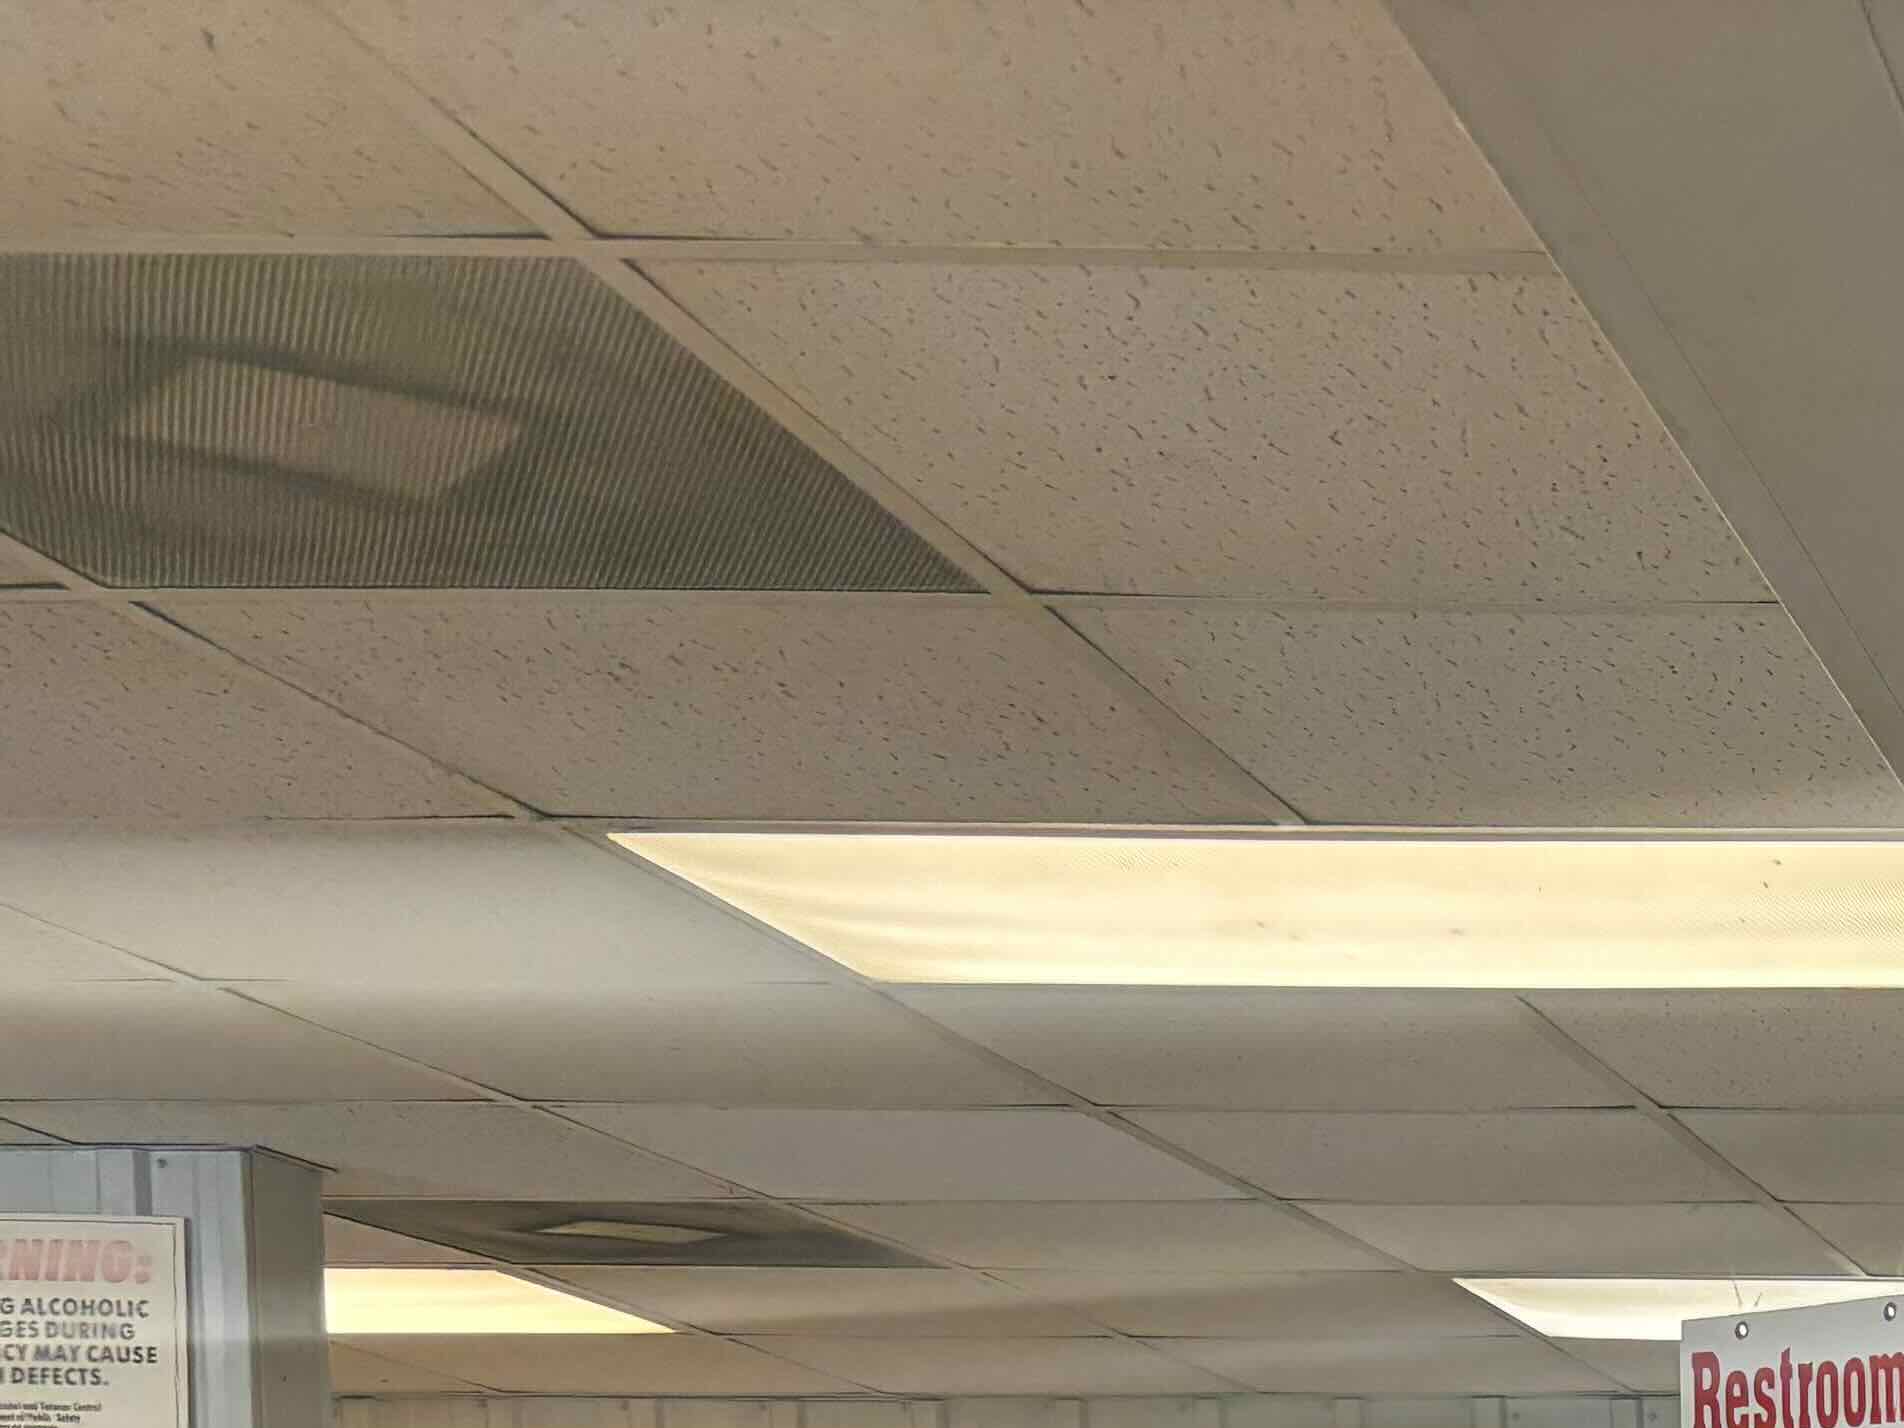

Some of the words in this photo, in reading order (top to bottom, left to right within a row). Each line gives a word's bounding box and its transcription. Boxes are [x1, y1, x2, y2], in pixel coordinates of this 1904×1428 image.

[0, 1239, 152, 1284] NING:
[21, 1298, 149, 1317] ALCOHOLIC
[45, 1321, 135, 1339] DURING
[33, 1345, 80, 1361] MAY
[87, 1345, 158, 1363] CAUSE
[11, 1367, 109, 1385] DEFECTS.
